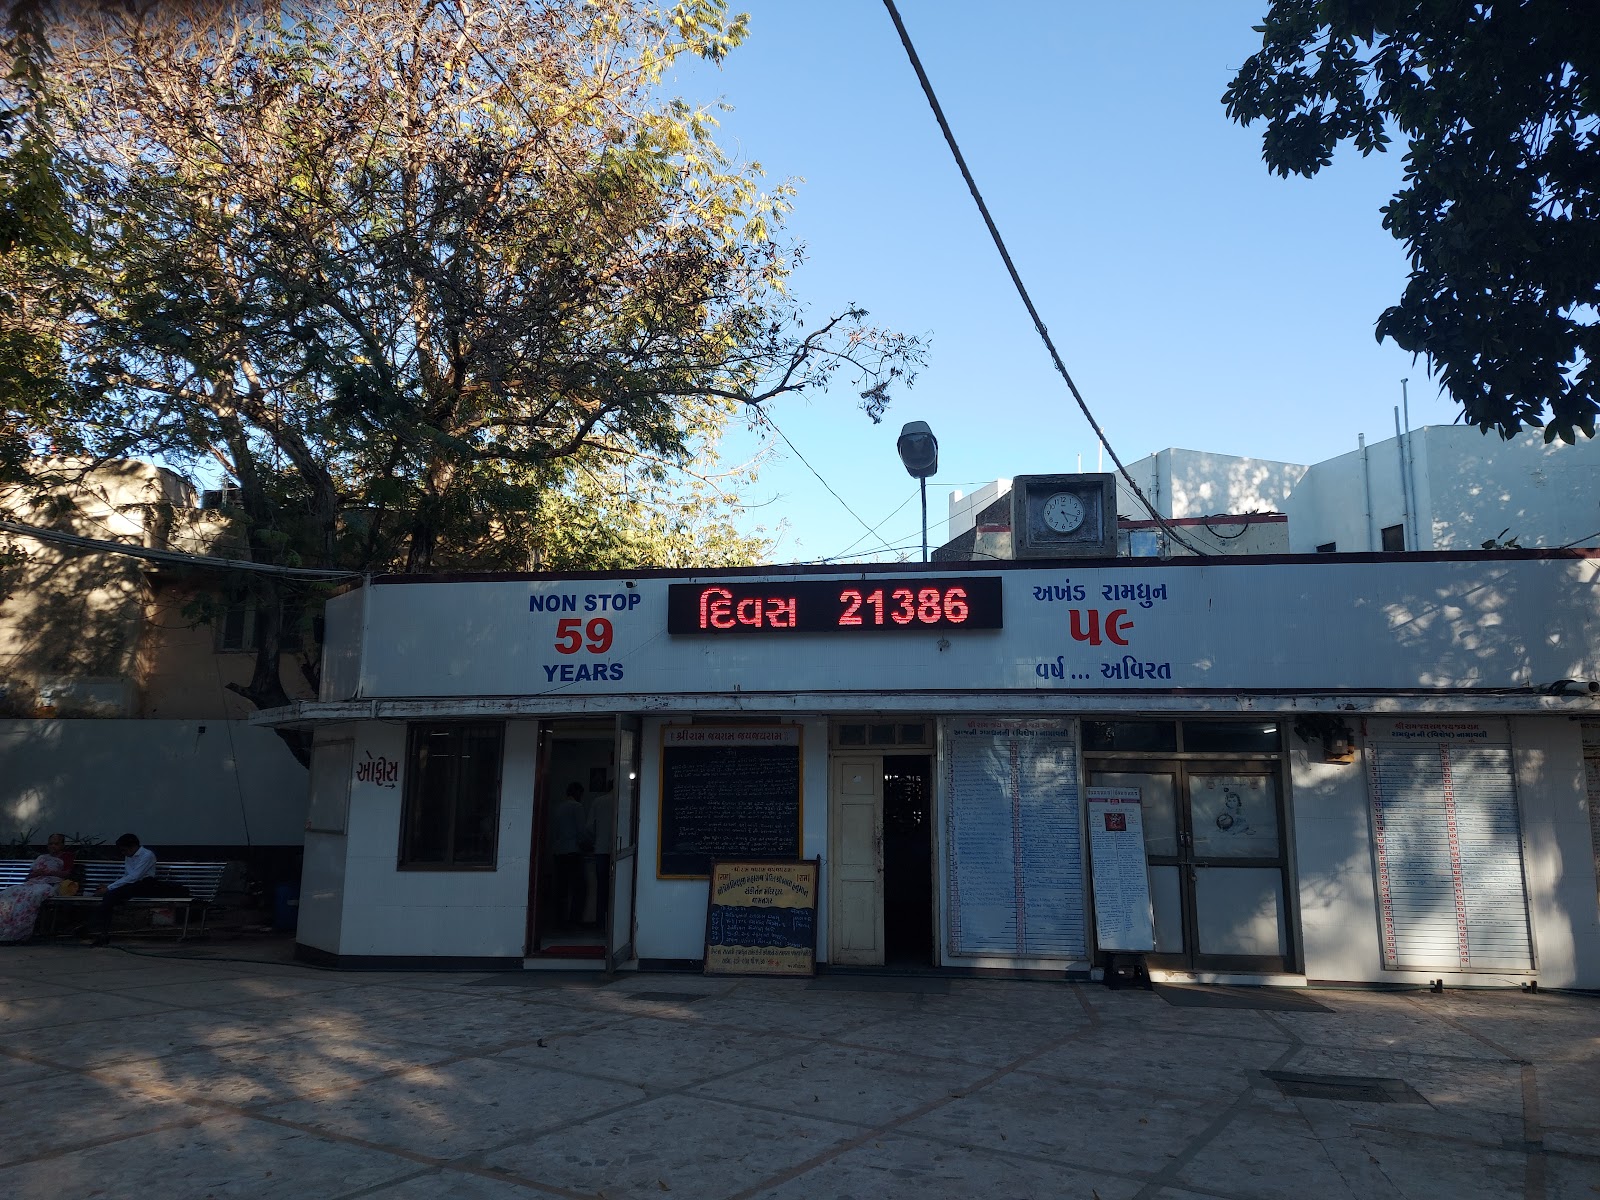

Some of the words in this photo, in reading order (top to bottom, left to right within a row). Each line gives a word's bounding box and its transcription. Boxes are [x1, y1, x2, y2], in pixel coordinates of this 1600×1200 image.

[529, 595, 576, 612] NON
[584, 593, 641, 611] STOP
[700, 588, 796, 629] દિવસ
[838, 588, 970, 625] 21386
[1032, 578, 1086, 602] અખંડ
[1101, 583, 1168, 609] રામધુન
[554, 617, 614, 655] 59
[1068, 609, 1134, 646] ૫૯
[543, 662, 624, 682] YEARS
[1100, 655, 1172, 680] અવિરત
